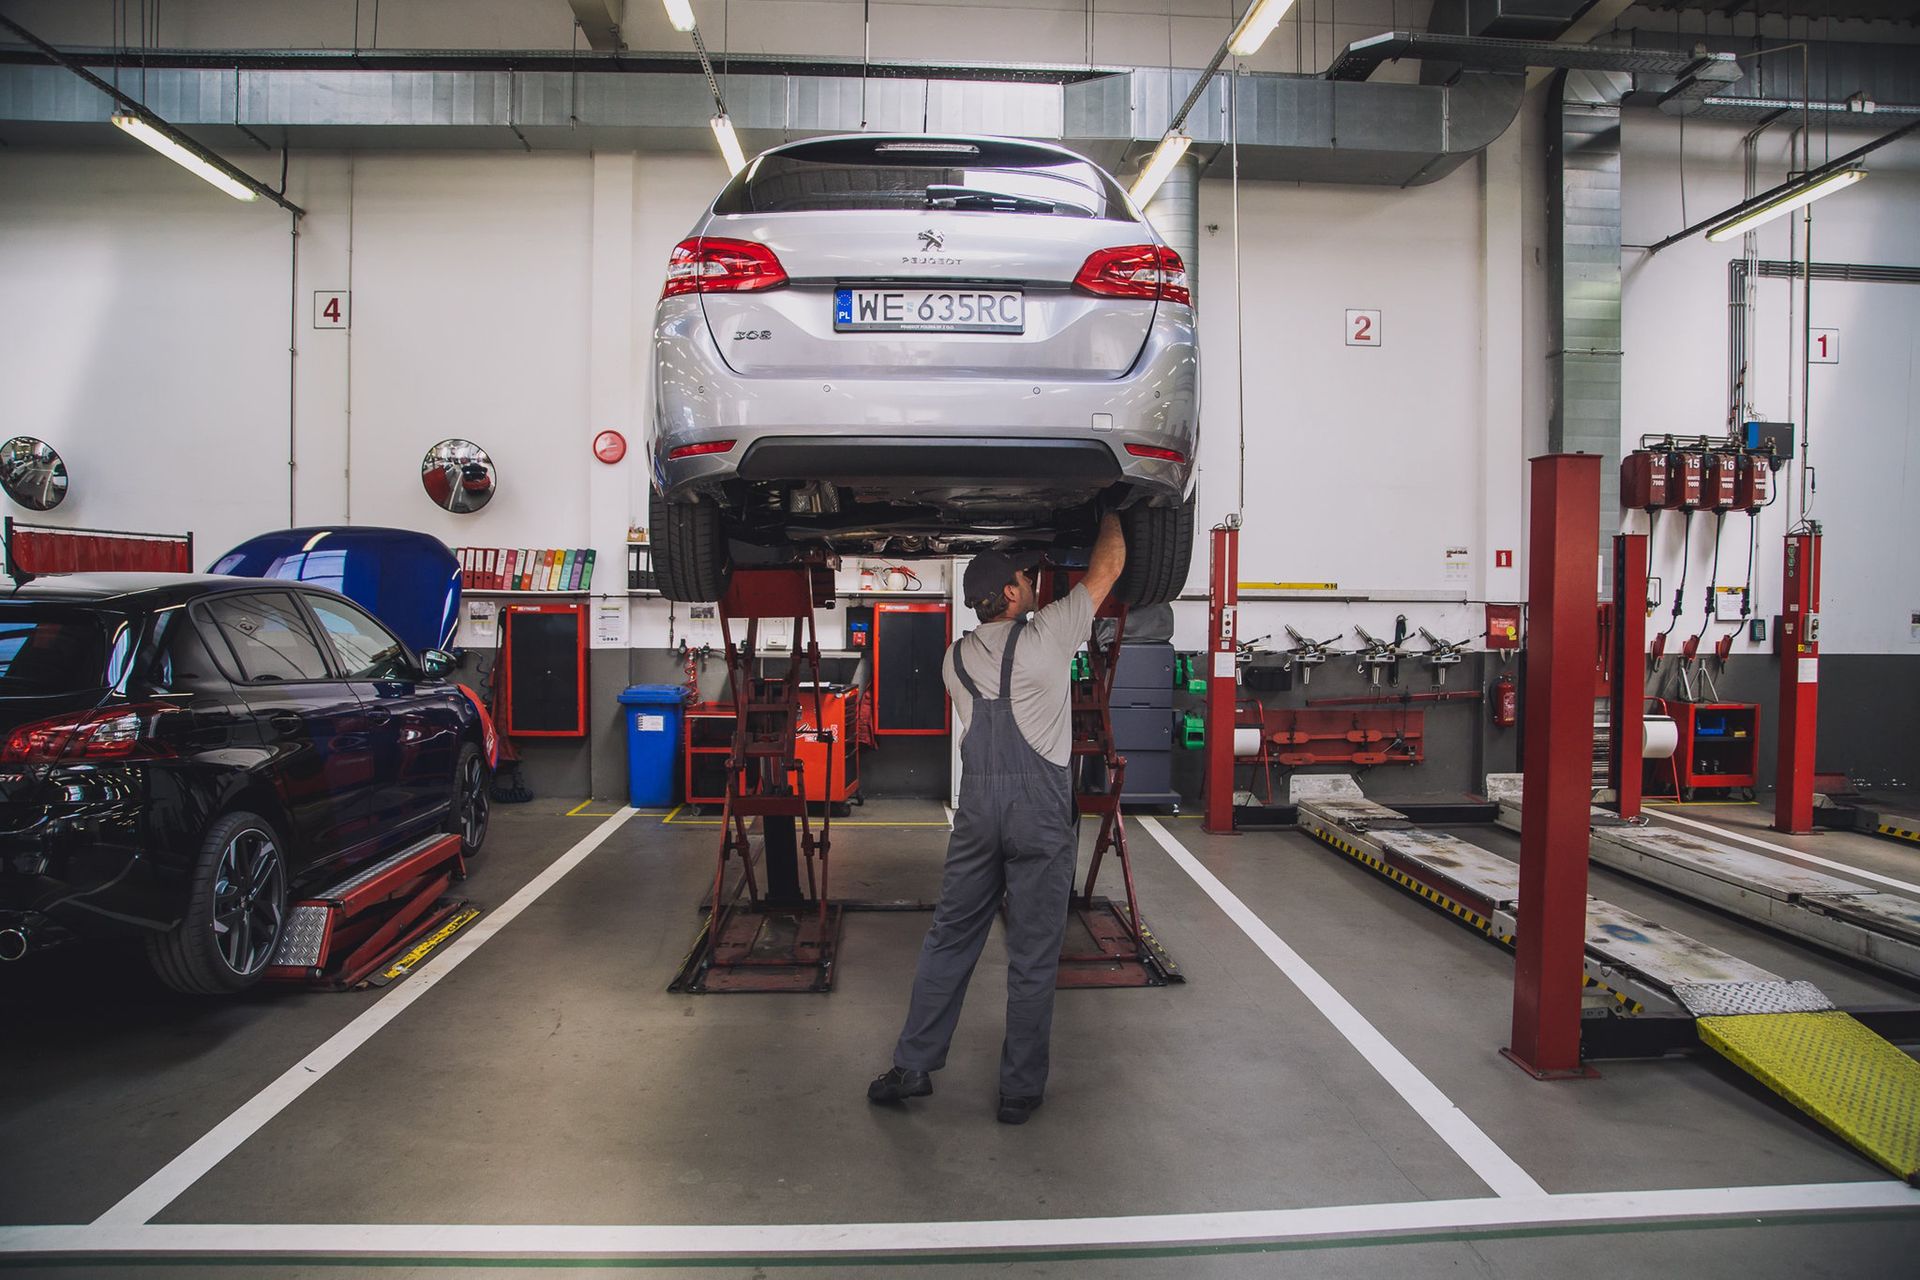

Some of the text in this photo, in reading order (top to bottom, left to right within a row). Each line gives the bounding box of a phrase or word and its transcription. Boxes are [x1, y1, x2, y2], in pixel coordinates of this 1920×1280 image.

[902, 257, 962, 265] PEUGEOT
[323, 298, 341, 322] 4
[859, 294, 1018, 323] WE 635RC
[839, 311, 850, 320] PL
[1354, 315, 1371, 340] 2
[733, 330, 772, 341] 308
[1817, 334, 1827, 357] 1
[1653, 457, 1666, 467] 14
[1687, 458, 1700, 469] 15
[1722, 460, 1735, 471] 16
[1756, 461, 1768, 471] 17
